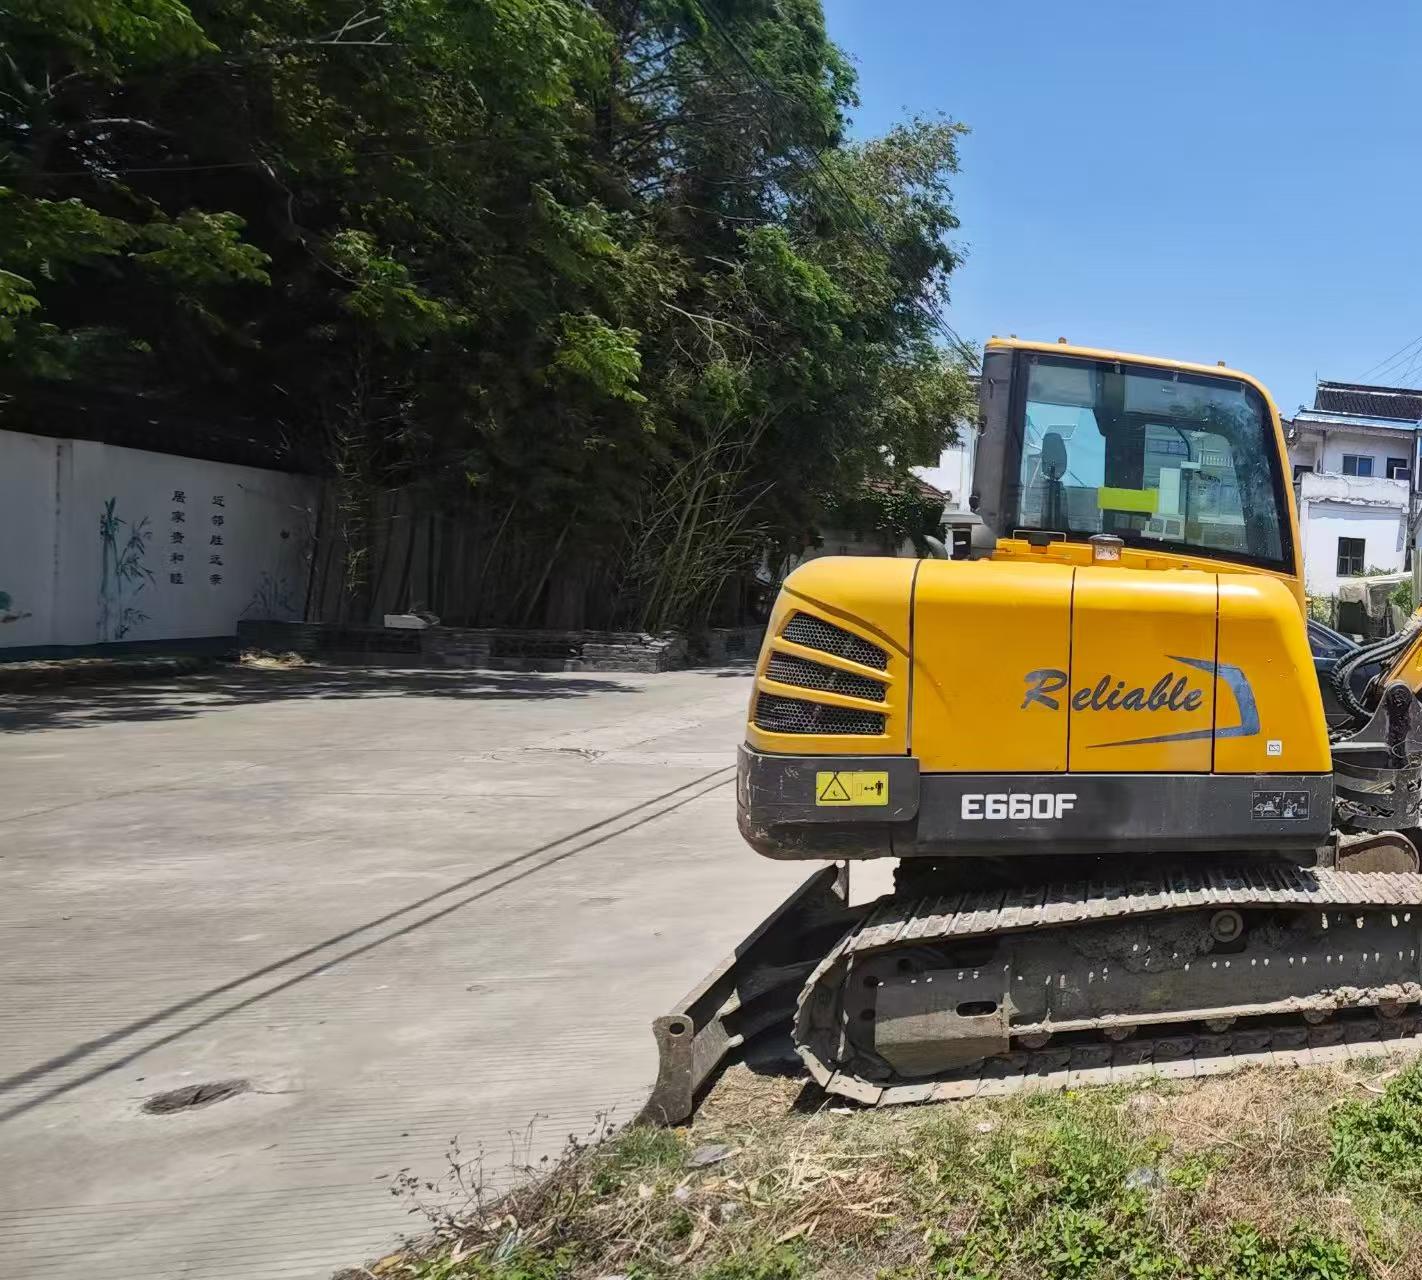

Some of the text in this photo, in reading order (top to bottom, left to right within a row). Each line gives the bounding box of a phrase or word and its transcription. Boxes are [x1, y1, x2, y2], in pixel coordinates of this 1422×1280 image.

[169, 490, 186, 585] 居家贵和睦
[1020, 668, 1203, 712] Reliable
[961, 793, 1078, 820] E660F
